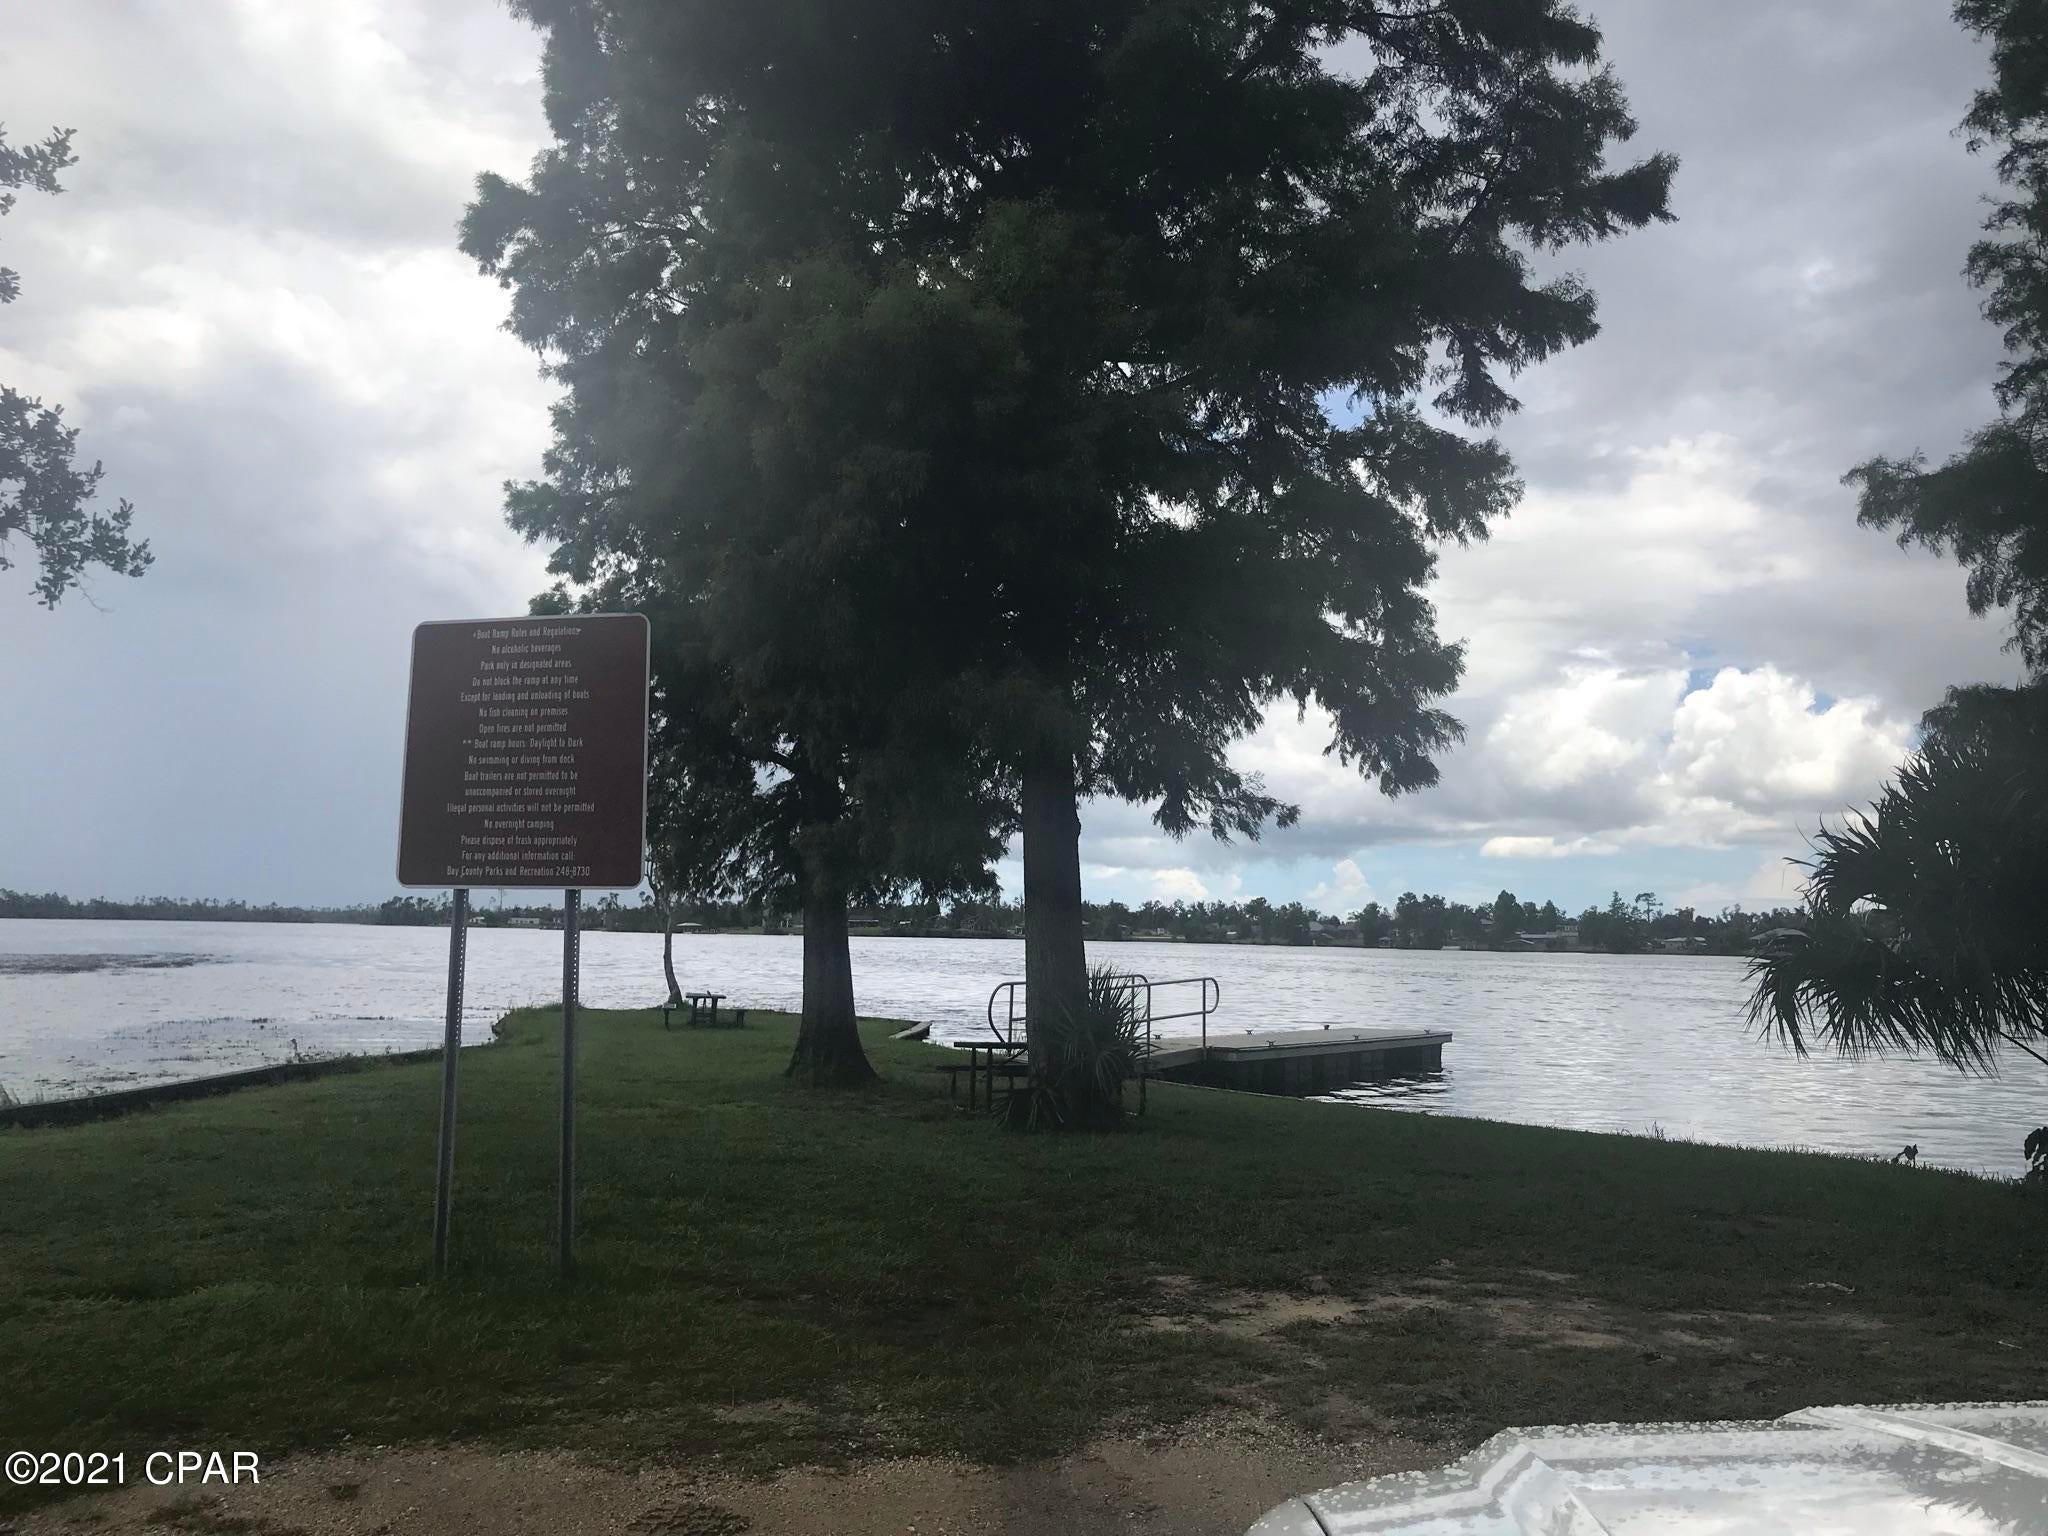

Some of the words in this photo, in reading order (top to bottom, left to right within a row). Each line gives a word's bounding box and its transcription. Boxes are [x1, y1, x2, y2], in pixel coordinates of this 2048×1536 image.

[502, 644, 528, 653] alcoholic
[531, 644, 561, 654] beverages
[481, 661, 494, 670] Park
[497, 661, 509, 670] only
[520, 659, 552, 670] designated
[483, 677, 492, 686] not
[494, 677, 510, 686] block
[513, 676, 522, 685] the
[461, 692, 480, 703] Except
[517, 691, 528, 700] and
[489, 708, 500, 716] fish
[503, 708, 528, 718] cleaning
[540, 708, 568, 717] premises
[480, 724, 494, 734] Open
[525, 724, 534, 732] not
[537, 723, 567, 733] permitted
[560, 738, 565, 747] to
[568, 737, 583, 747] Dark
[520, 754, 540, 766] diving
[560, 755, 575, 763] dock
[529, 771, 559, 782] permitted
[564, 802, 594, 814] permitted
[486, 866, 503, 876] Parks
[520, 866, 554, 876] Recreation
